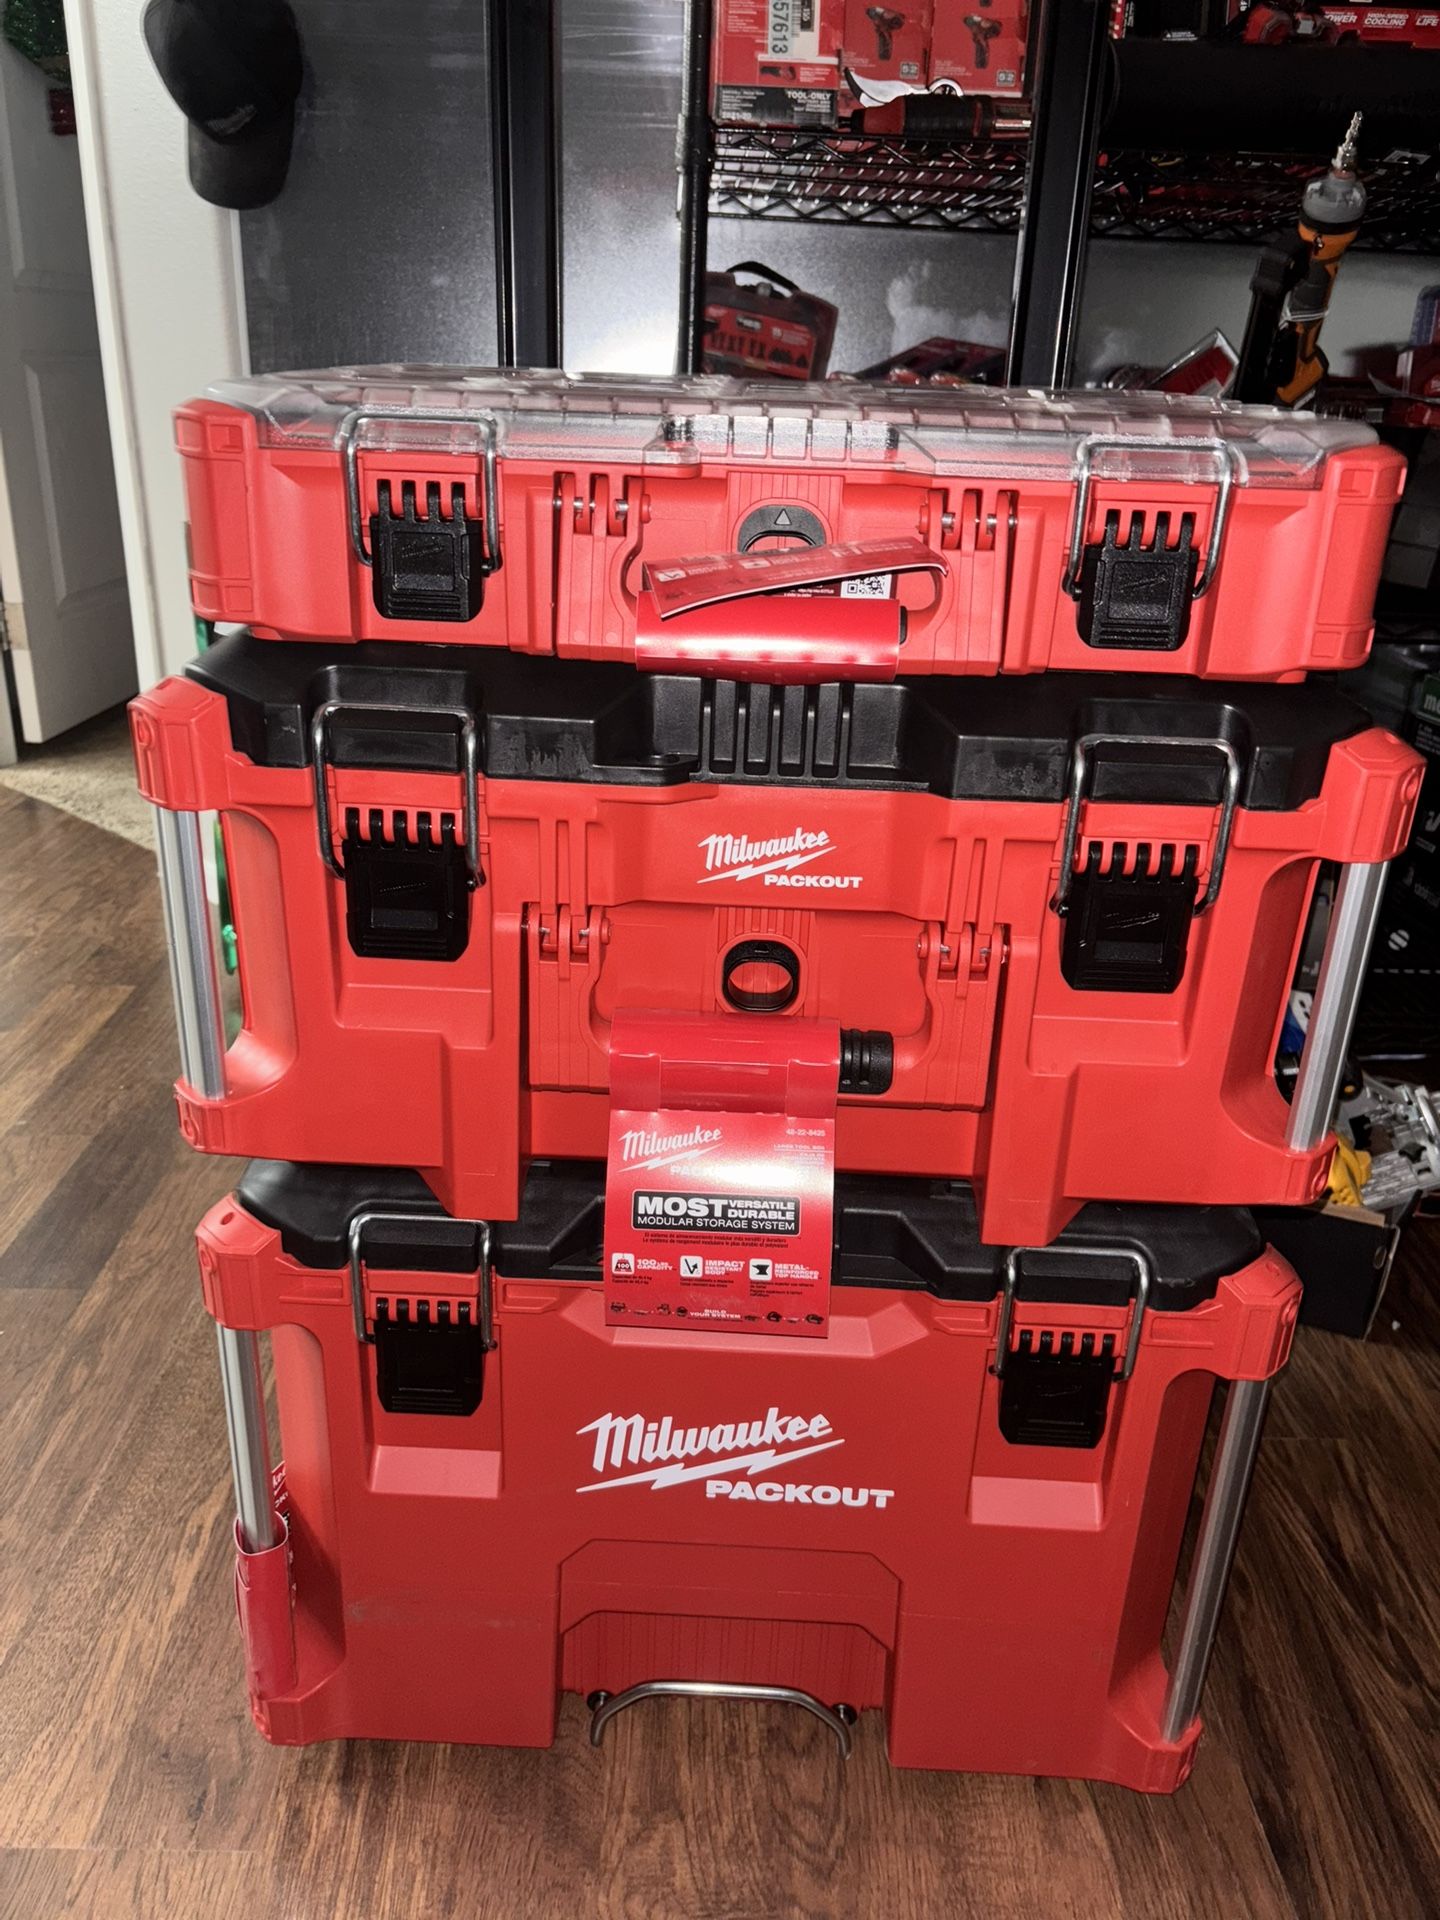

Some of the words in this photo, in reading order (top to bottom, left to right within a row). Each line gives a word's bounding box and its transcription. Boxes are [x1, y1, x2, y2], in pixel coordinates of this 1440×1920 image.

[1364, 18, 1406, 26] COOLING
[1415, 18, 1439, 26] LIFE
[787, 91, 831, 100] TOOL-ONLY
[698, 827, 830, 871] Milwaukee
[764, 874, 863, 888] PACKOUT
[618, 1125, 723, 1161] Milwaukee
[637, 1196, 728, 1217] MOST
[729, 1200, 795, 1210] VERSATILE
[728, 1209, 795, 1220] DURABLE
[637, 1216, 693, 1227] MODULAR
[696, 1218, 748, 1229] STORAGE
[752, 1220, 795, 1230] SYSTEM
[704, 1259, 745, 1268] IMPACT
[576, 1407, 833, 1473] Milwaukee
[706, 1480, 894, 1508] PACKOUT
